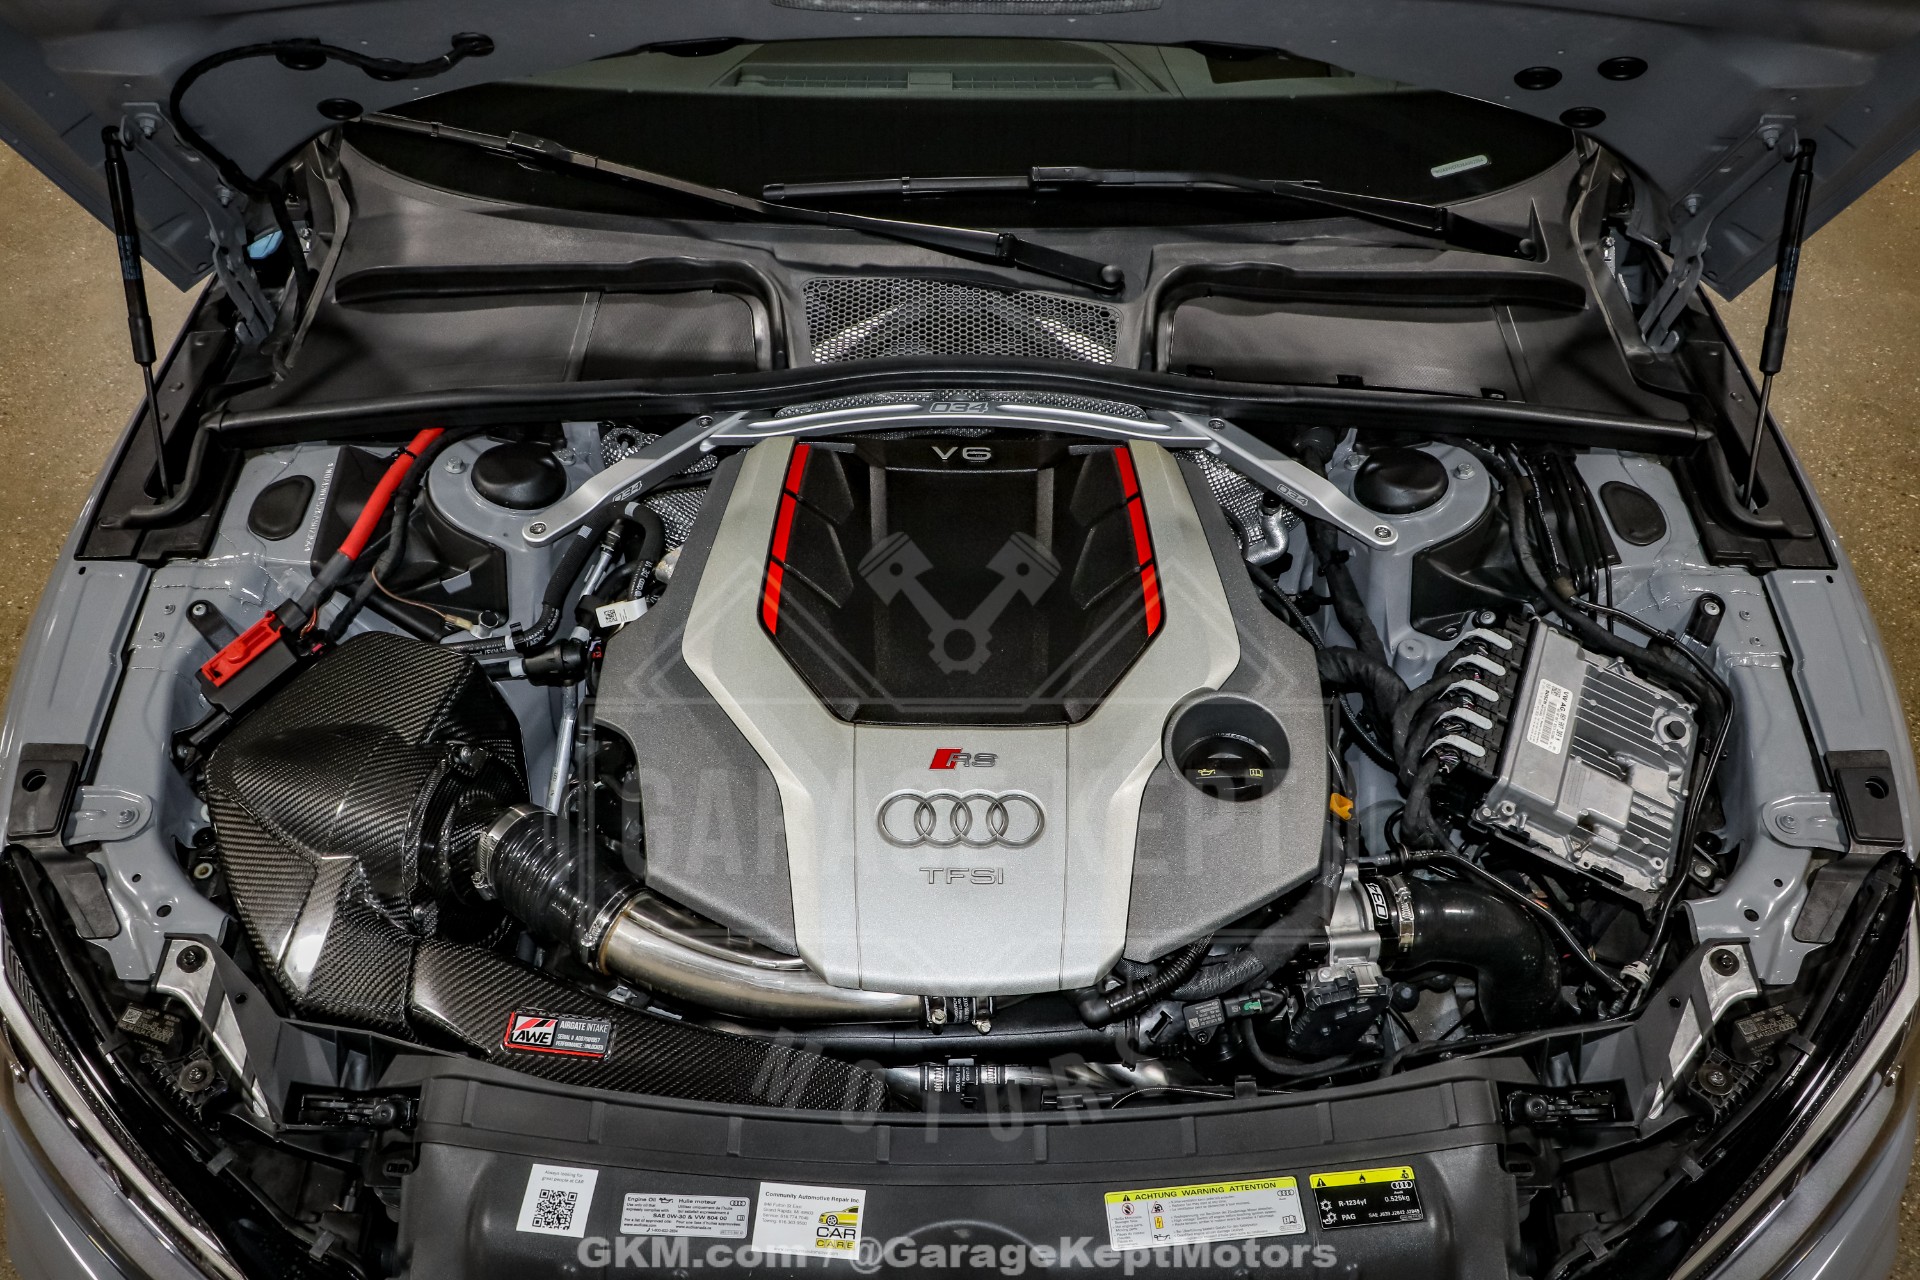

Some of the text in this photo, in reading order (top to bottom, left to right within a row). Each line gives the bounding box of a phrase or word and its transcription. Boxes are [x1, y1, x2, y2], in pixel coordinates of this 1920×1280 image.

[930, 402, 988, 413] 034
[931, 446, 991, 460] V6
[613, 480, 642, 502] 034
[1277, 484, 1308, 506] 034
[946, 752, 998, 768] RS
[920, 867, 1004, 884] TFSI
[1365, 882, 1388, 920] 034
[560, 1021, 609, 1033] AIRGATE INTAKE
[515, 1030, 552, 1044] AWE
[1135, 1191, 1177, 1200] ACHTUNG
[1181, 1187, 1225, 1196] WARNING
[1229, 1182, 1276, 1192] ATTENTION
[1338, 1199, 1367, 1207] R-1234yf
[817, 1227, 856, 1239] CAR
[817, 1240, 853, 1248] CARE
